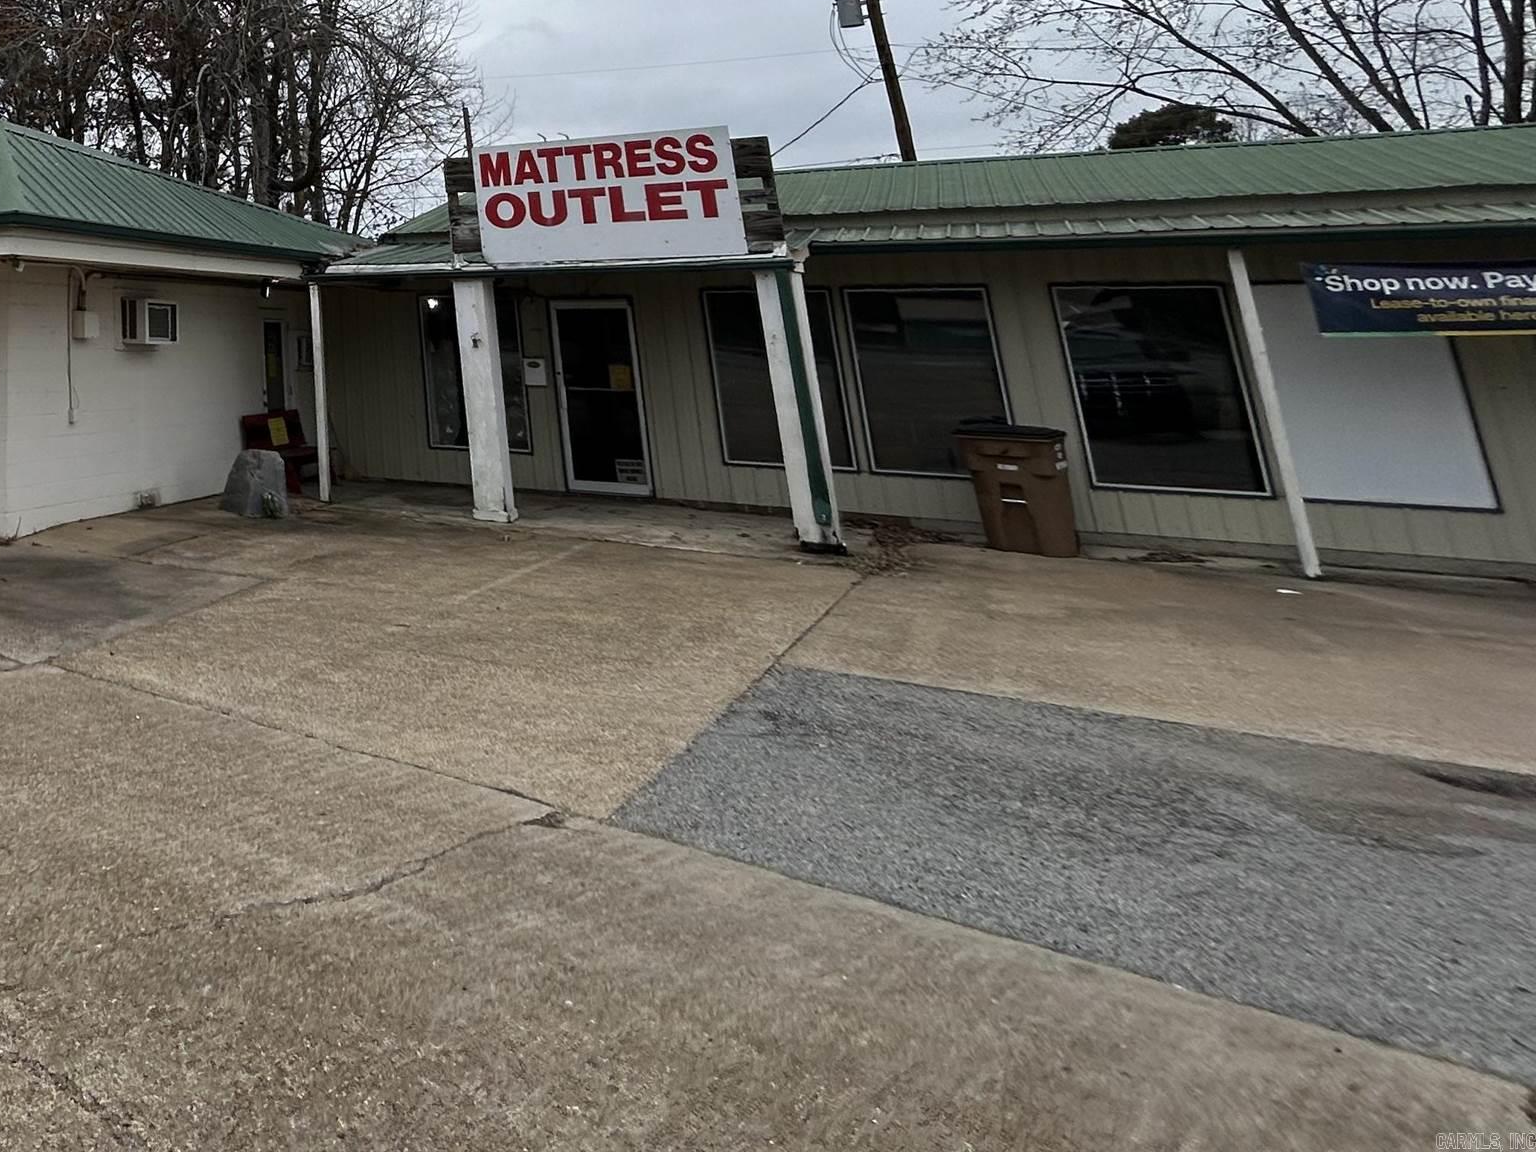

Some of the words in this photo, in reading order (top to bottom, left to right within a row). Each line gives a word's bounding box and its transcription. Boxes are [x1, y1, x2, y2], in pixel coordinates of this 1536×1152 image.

[478, 133, 718, 188] MATTRESS
[484, 178, 729, 229] OUTLET
[1324, 274, 1401, 295] Shop
[1405, 276, 1479, 291] now.
[1481, 271, 1536, 292] Pay
[1370, 298, 1497, 309] Lease-to-own
